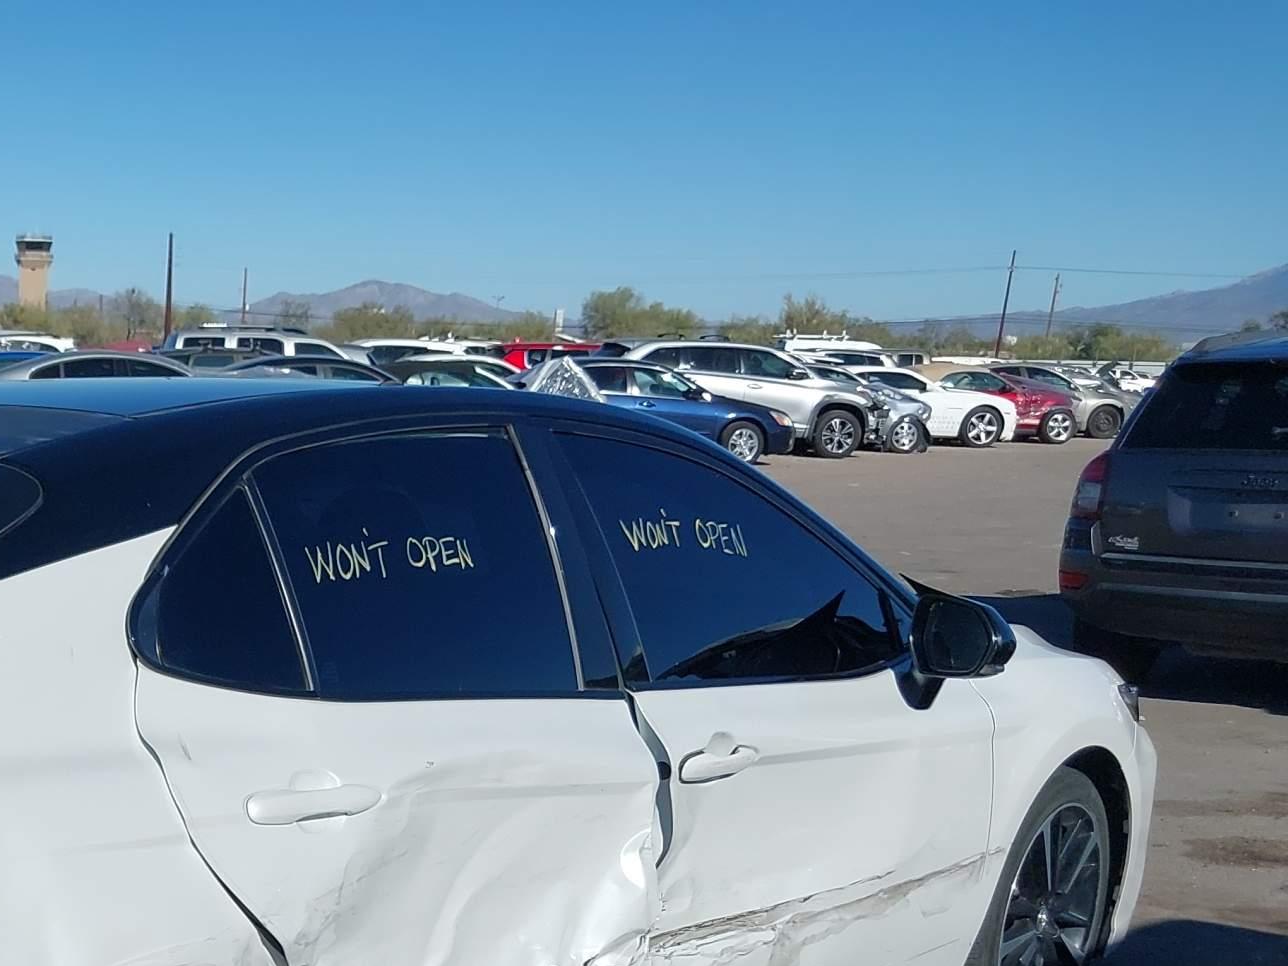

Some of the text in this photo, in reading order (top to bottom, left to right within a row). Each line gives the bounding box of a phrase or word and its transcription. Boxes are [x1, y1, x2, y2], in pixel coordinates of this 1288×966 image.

[305, 528, 474, 583] WON'T OPEN
[619, 508, 748, 557] WON'T OPEN
